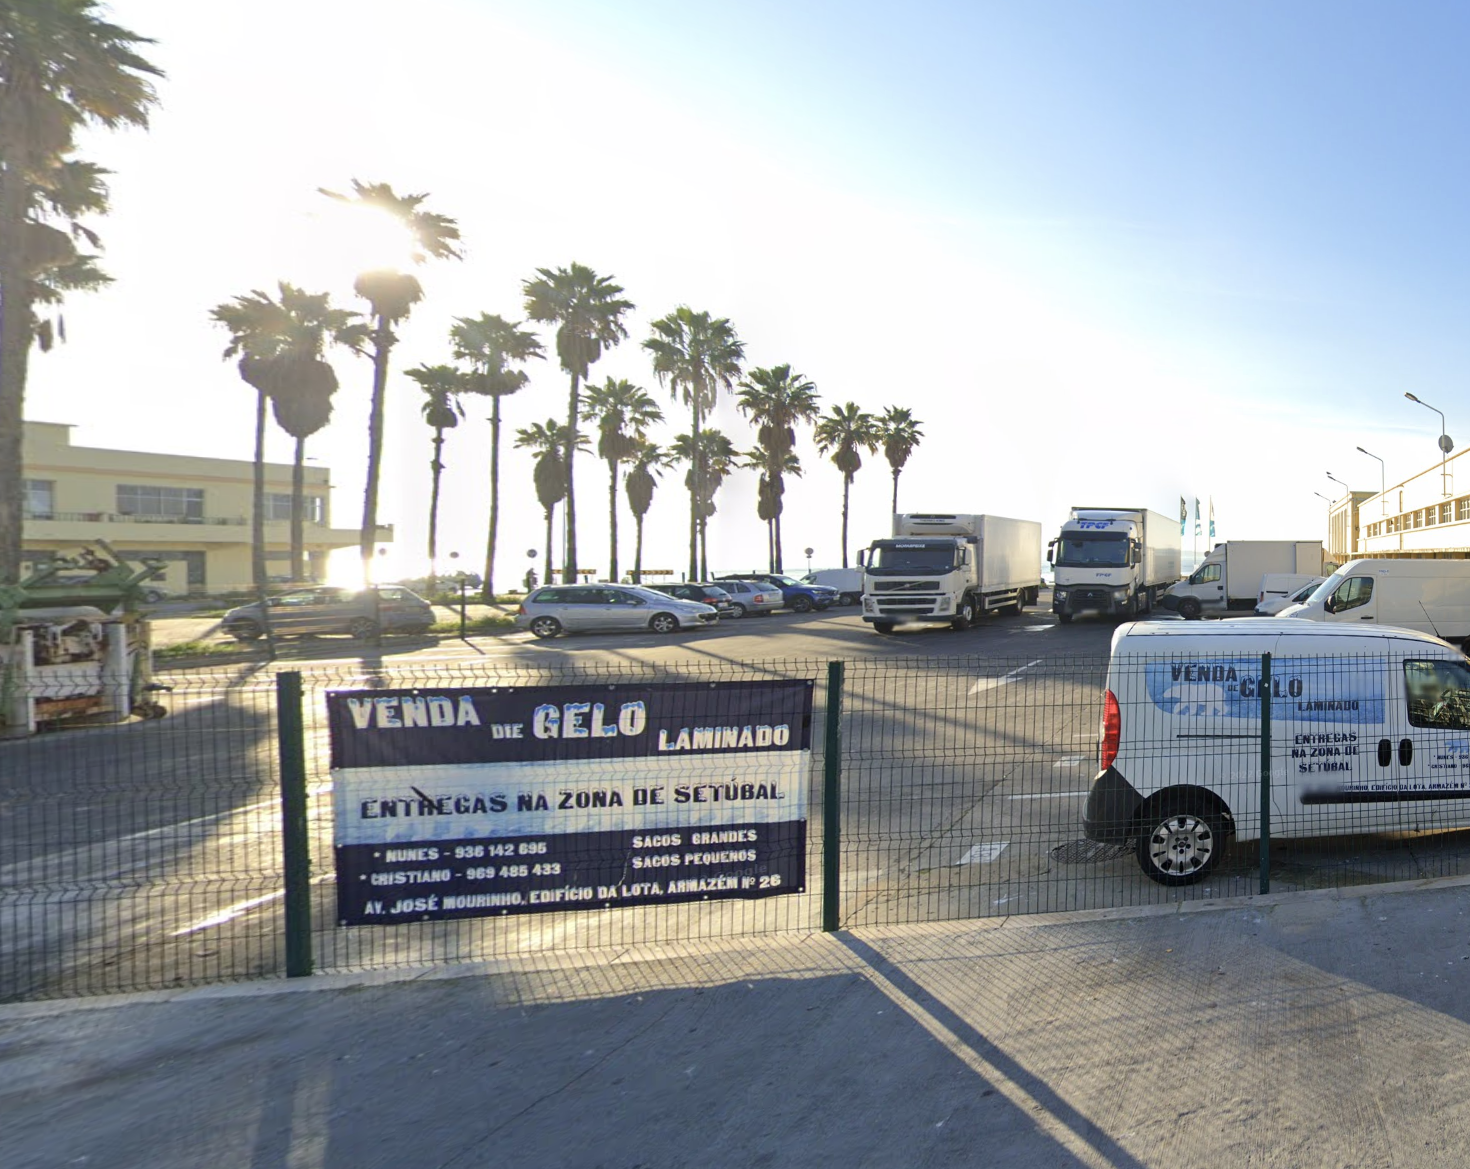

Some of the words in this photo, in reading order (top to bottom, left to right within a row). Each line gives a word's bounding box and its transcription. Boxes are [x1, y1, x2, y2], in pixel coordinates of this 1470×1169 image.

[1171, 662, 1237, 682] VENDA
[1228, 684, 1239, 692] DE
[1240, 675, 1303, 698] GLO
[347, 695, 481, 729] VENDA
[1298, 699, 1359, 712] LAMINADO
[533, 700, 646, 739] GELO
[658, 724, 789, 751] LAMINADO
[1294, 732, 1357, 744] ENTREGAS
[1292, 748, 1306, 758] NA
[1310, 746, 1341, 758] ZONA
[1345, 745, 1359, 756] DE
[1298, 759, 1352, 773] SETÚBAL
[361, 792, 508, 819] ENTREGAS
[517, 790, 549, 812] NA
[558, 786, 623, 810] ZONA
[633, 785, 665, 806] DE
[674, 777, 785, 803] SETÚBAL
[632, 834, 681, 849] SACOS
[691, 829, 758, 845] GRANDES
[386, 848, 439, 863] NUNES
[455, 845, 484, 859] 936
[488, 843, 515, 857] 142
[518, 842, 547, 855] 695
[632, 853, 681, 869] SACOS
[684, 849, 757, 866] PEQUENOS
[370, 869, 451, 886] CRISTIANO
[466, 866, 495, 880] 969
[499, 864, 528, 878] 485
[532, 862, 561, 876] 433
[364, 901, 387, 915] AV.
[390, 894, 438, 914] JOSÉ
[529, 885, 593, 904] EDIFÍCIO
[597, 885, 617, 900] DA
[622, 882, 663, 897] LOTA,
[667, 874, 738, 894] ARMAZÉM
[759, 873, 781, 889] 26
